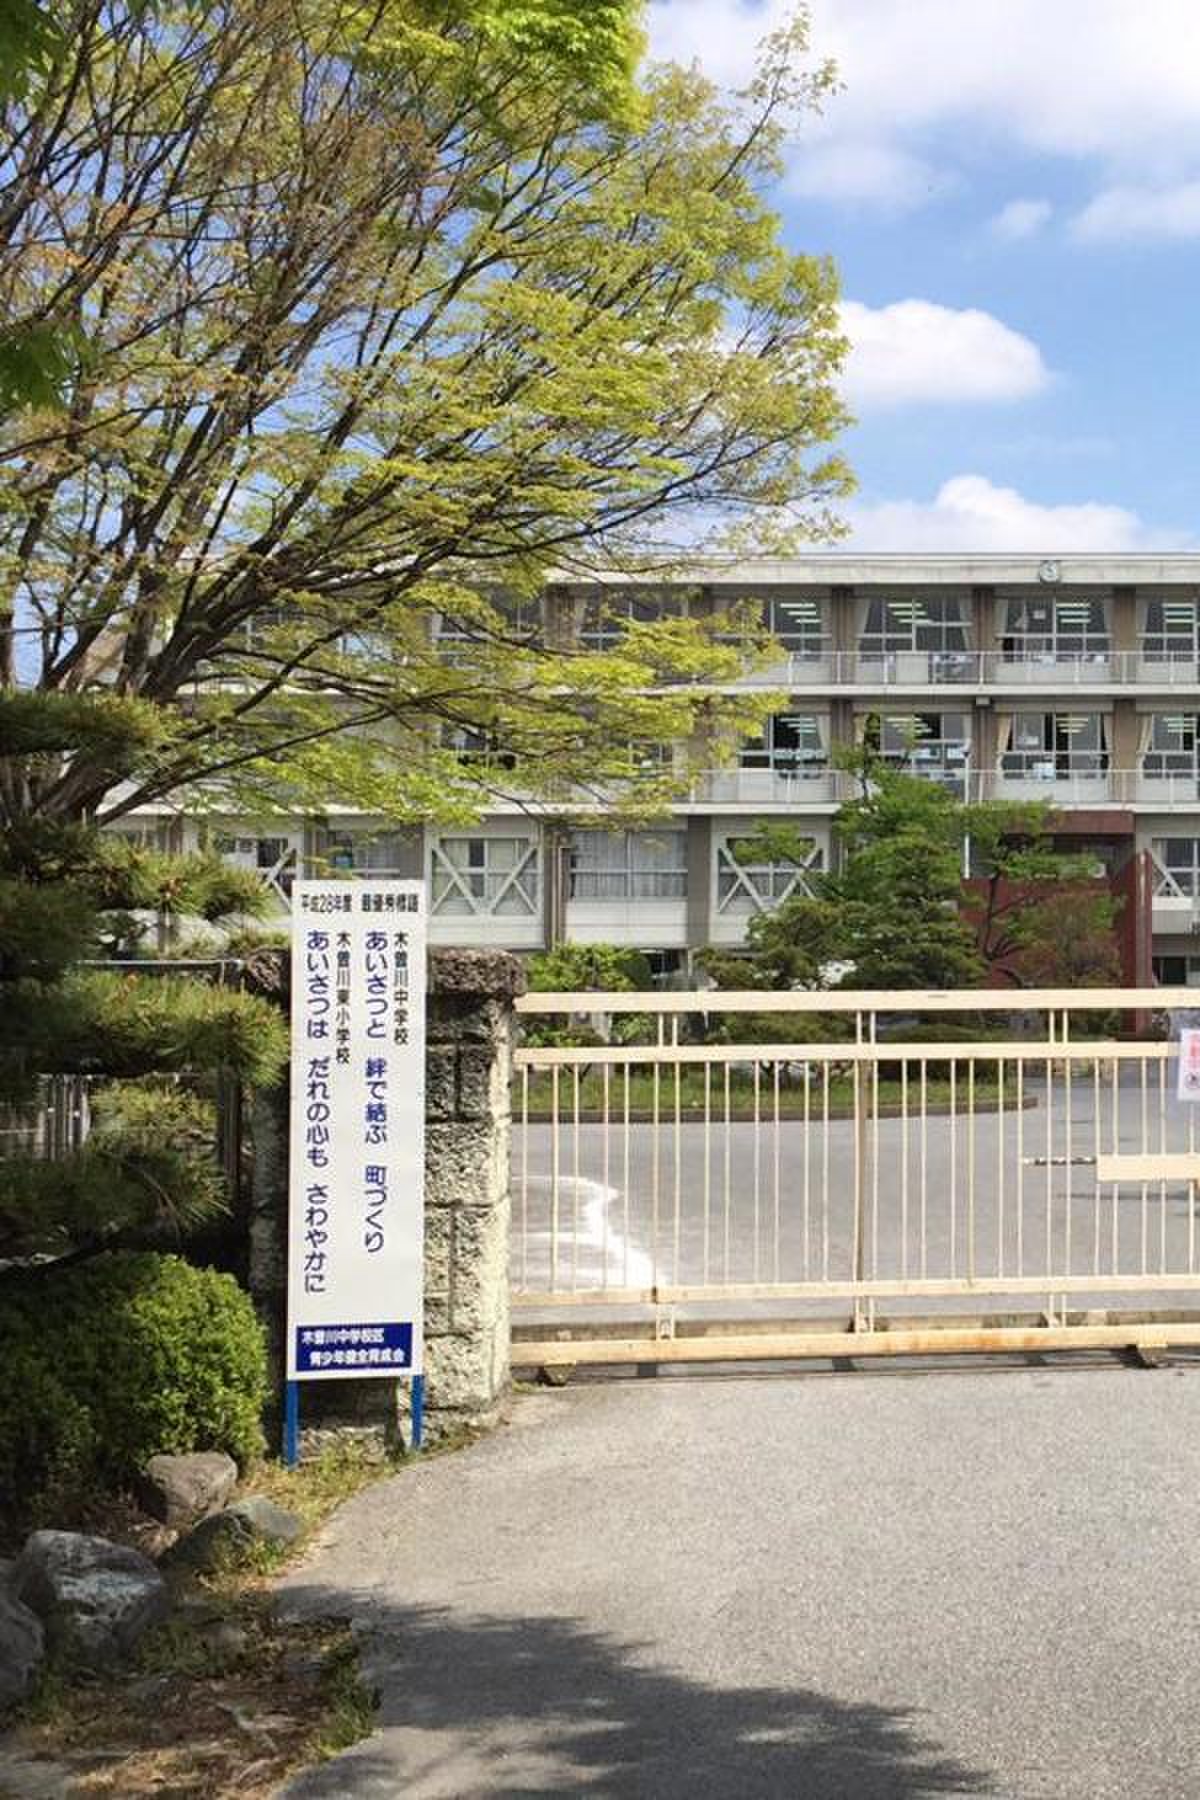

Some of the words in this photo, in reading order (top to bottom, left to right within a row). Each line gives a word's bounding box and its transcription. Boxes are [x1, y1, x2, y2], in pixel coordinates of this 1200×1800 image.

[307, 931, 330, 1039] あいさつは
[365, 931, 388, 1039] あいさつと
[306, 1057, 330, 1168] だれの心も
[365, 1057, 388, 1144] 絆で結ぶ
[304, 1184, 328, 1293] さわやかに
[364, 1165, 387, 1252] 町づくり
